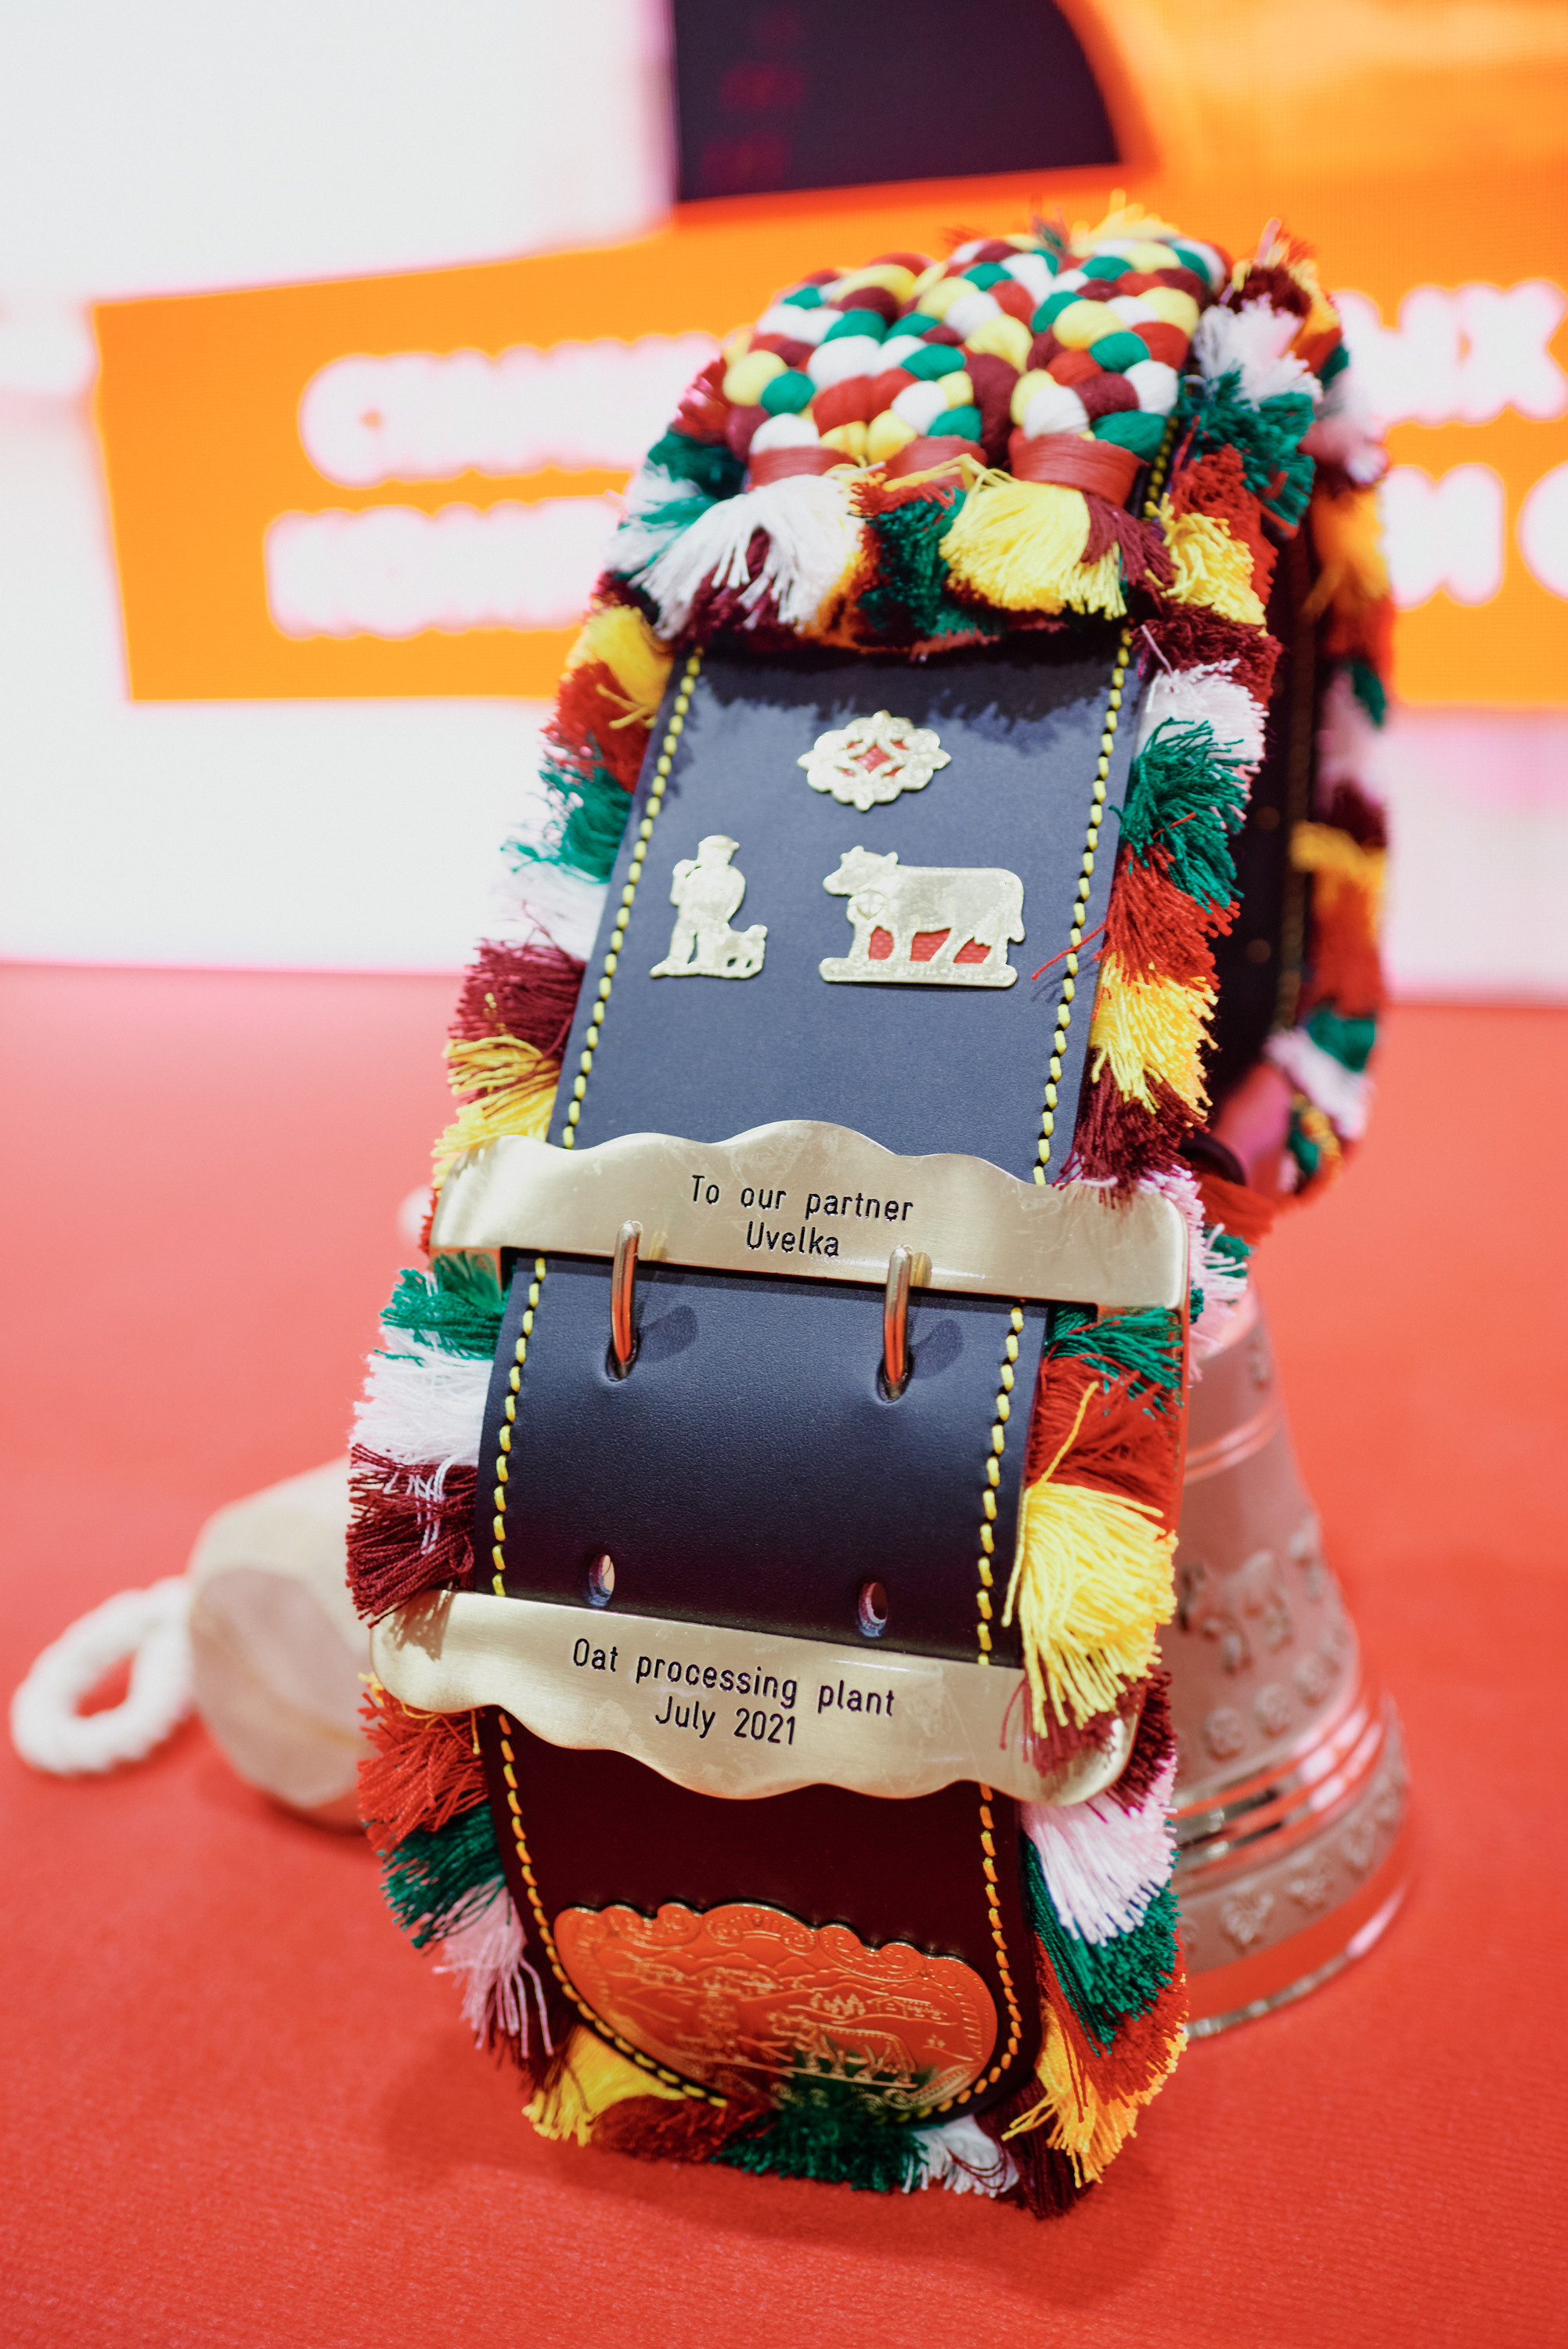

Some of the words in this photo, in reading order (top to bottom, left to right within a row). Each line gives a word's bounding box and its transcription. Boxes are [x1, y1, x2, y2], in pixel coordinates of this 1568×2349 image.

[692, 1174, 719, 1204] To
[741, 1187, 787, 1210] our
[805, 1193, 914, 1221] partner
[746, 1220, 839, 1257] Uvelka
[573, 1638, 618, 1672] Oat
[636, 1655, 798, 1709] processing
[817, 1680, 895, 1716] plant
[654, 1695, 716, 1739] July
[734, 1708, 796, 1745] 2021
